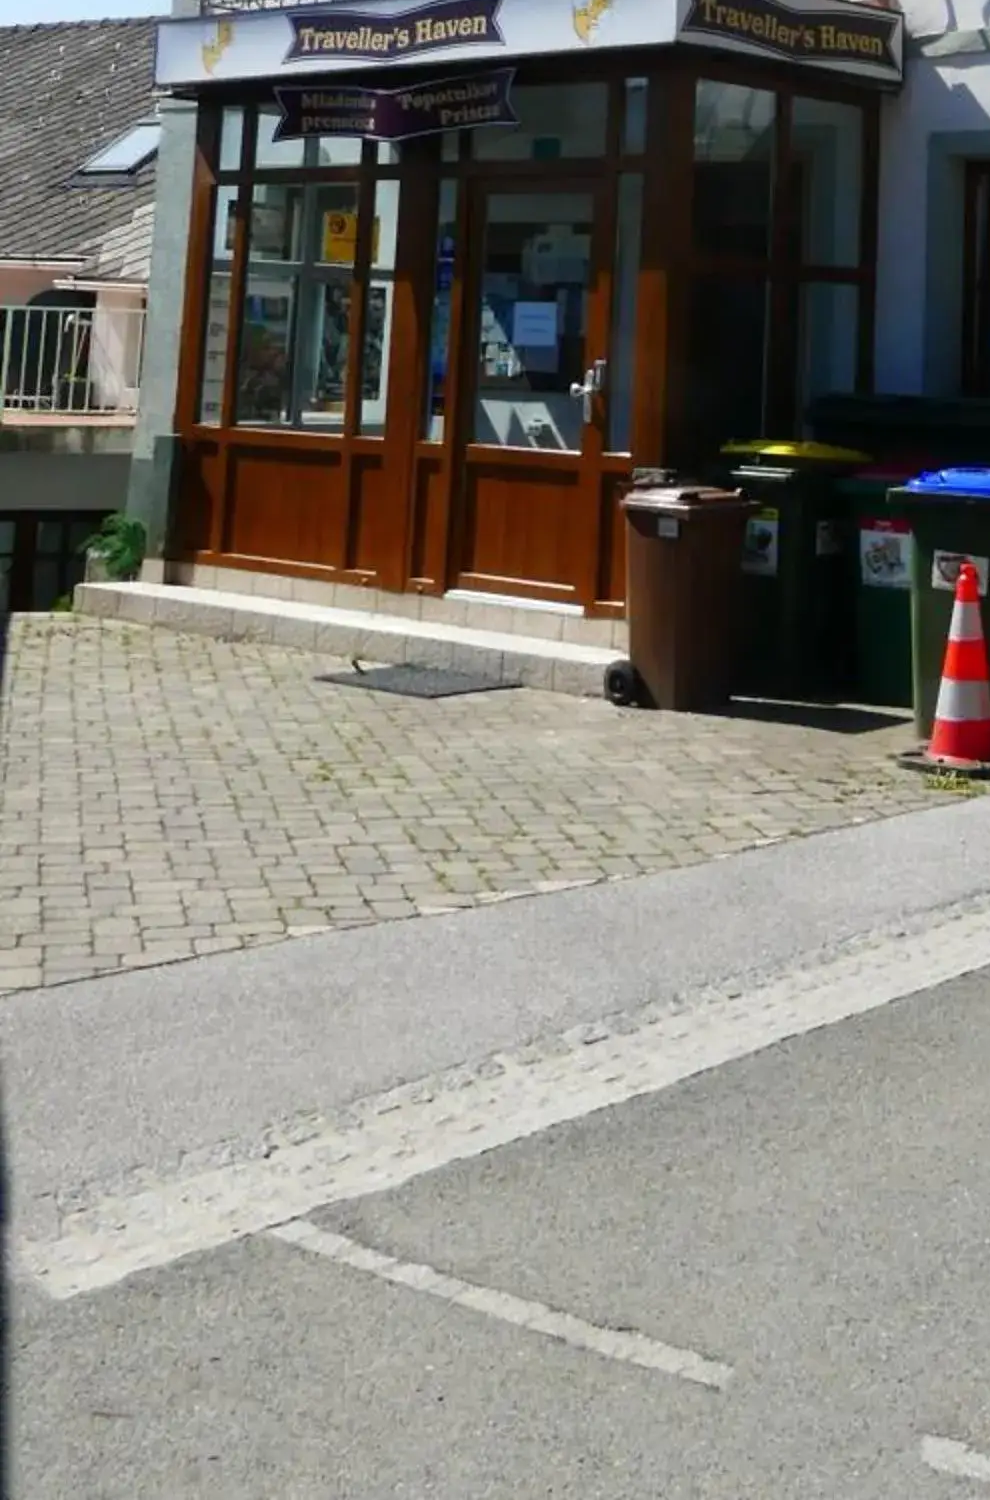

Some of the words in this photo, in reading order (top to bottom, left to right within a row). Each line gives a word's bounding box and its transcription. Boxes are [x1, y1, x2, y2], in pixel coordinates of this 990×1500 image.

[301, 26, 410, 51] Traveller's
[415, 15, 487, 44] Haven
[820, 25, 883, 55] Haven
